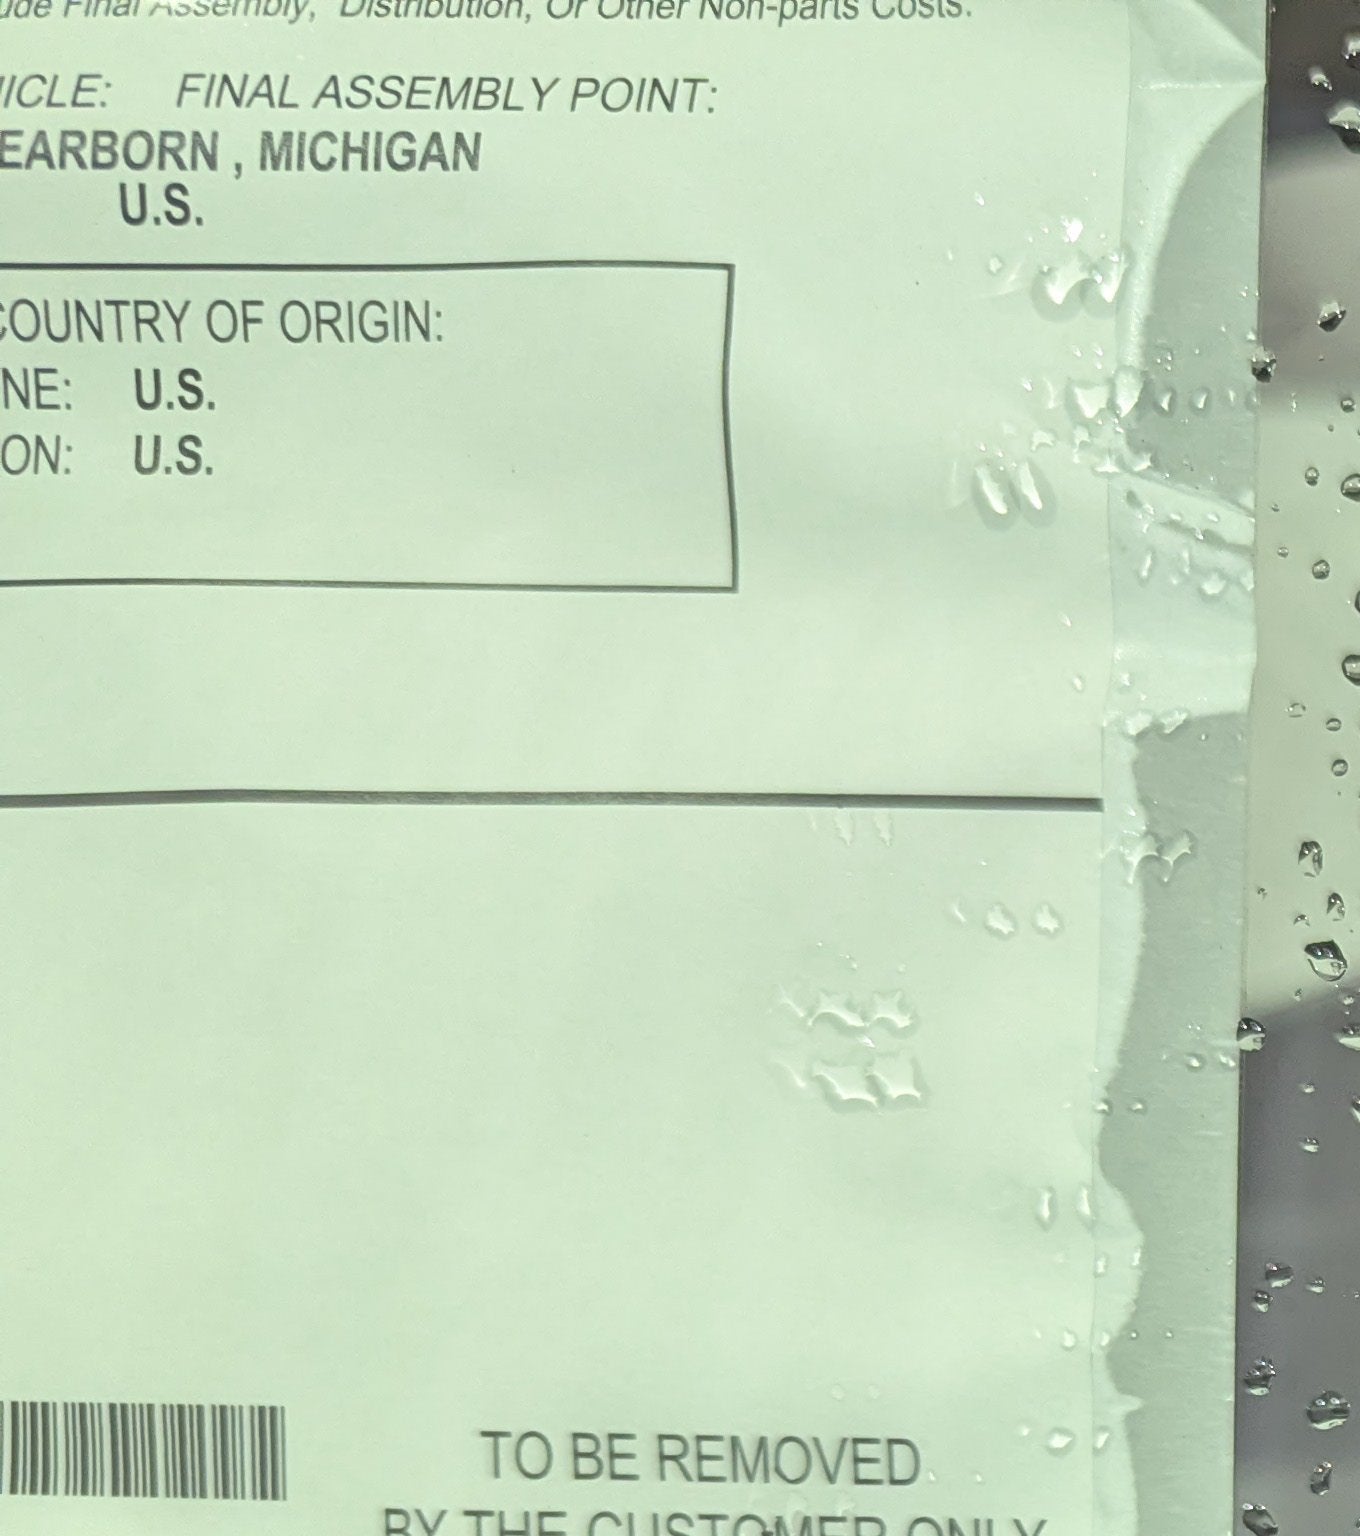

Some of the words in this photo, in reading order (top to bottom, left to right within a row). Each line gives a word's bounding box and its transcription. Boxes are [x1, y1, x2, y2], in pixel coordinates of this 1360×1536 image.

[64, 0, 141, 17] Final
[149, 0, 317, 24] Assembly,
[339, 0, 532, 23] Distribution,
[546, 0, 587, 19] Or
[598, 0, 688, 19] Other
[699, 0, 861, 27] Non-parts
[872, 0, 973, 19] Costs.
[0, 74, 112, 109] ICLE:
[176, 73, 300, 109] FINAL
[312, 74, 560, 112] ASSEMBLY
[570, 77, 719, 114] POINT:
[0, 130, 220, 171] EARBORN
[260, 131, 482, 172] MICHIGAN
[119, 182, 204, 226] U.S.
[0, 298, 192, 343] OUNTRY
[206, 299, 264, 343] OF
[280, 300, 443, 343] ORIGIN:
[2, 367, 73, 411] NE:
[134, 367, 216, 411] U.S.
[1, 434, 73, 475] ON:
[134, 434, 214, 476] U.S.
[480, 1430, 554, 1480] TO
[570, 1433, 640, 1482] BE
[657, 1435, 923, 1487] REMOVED
